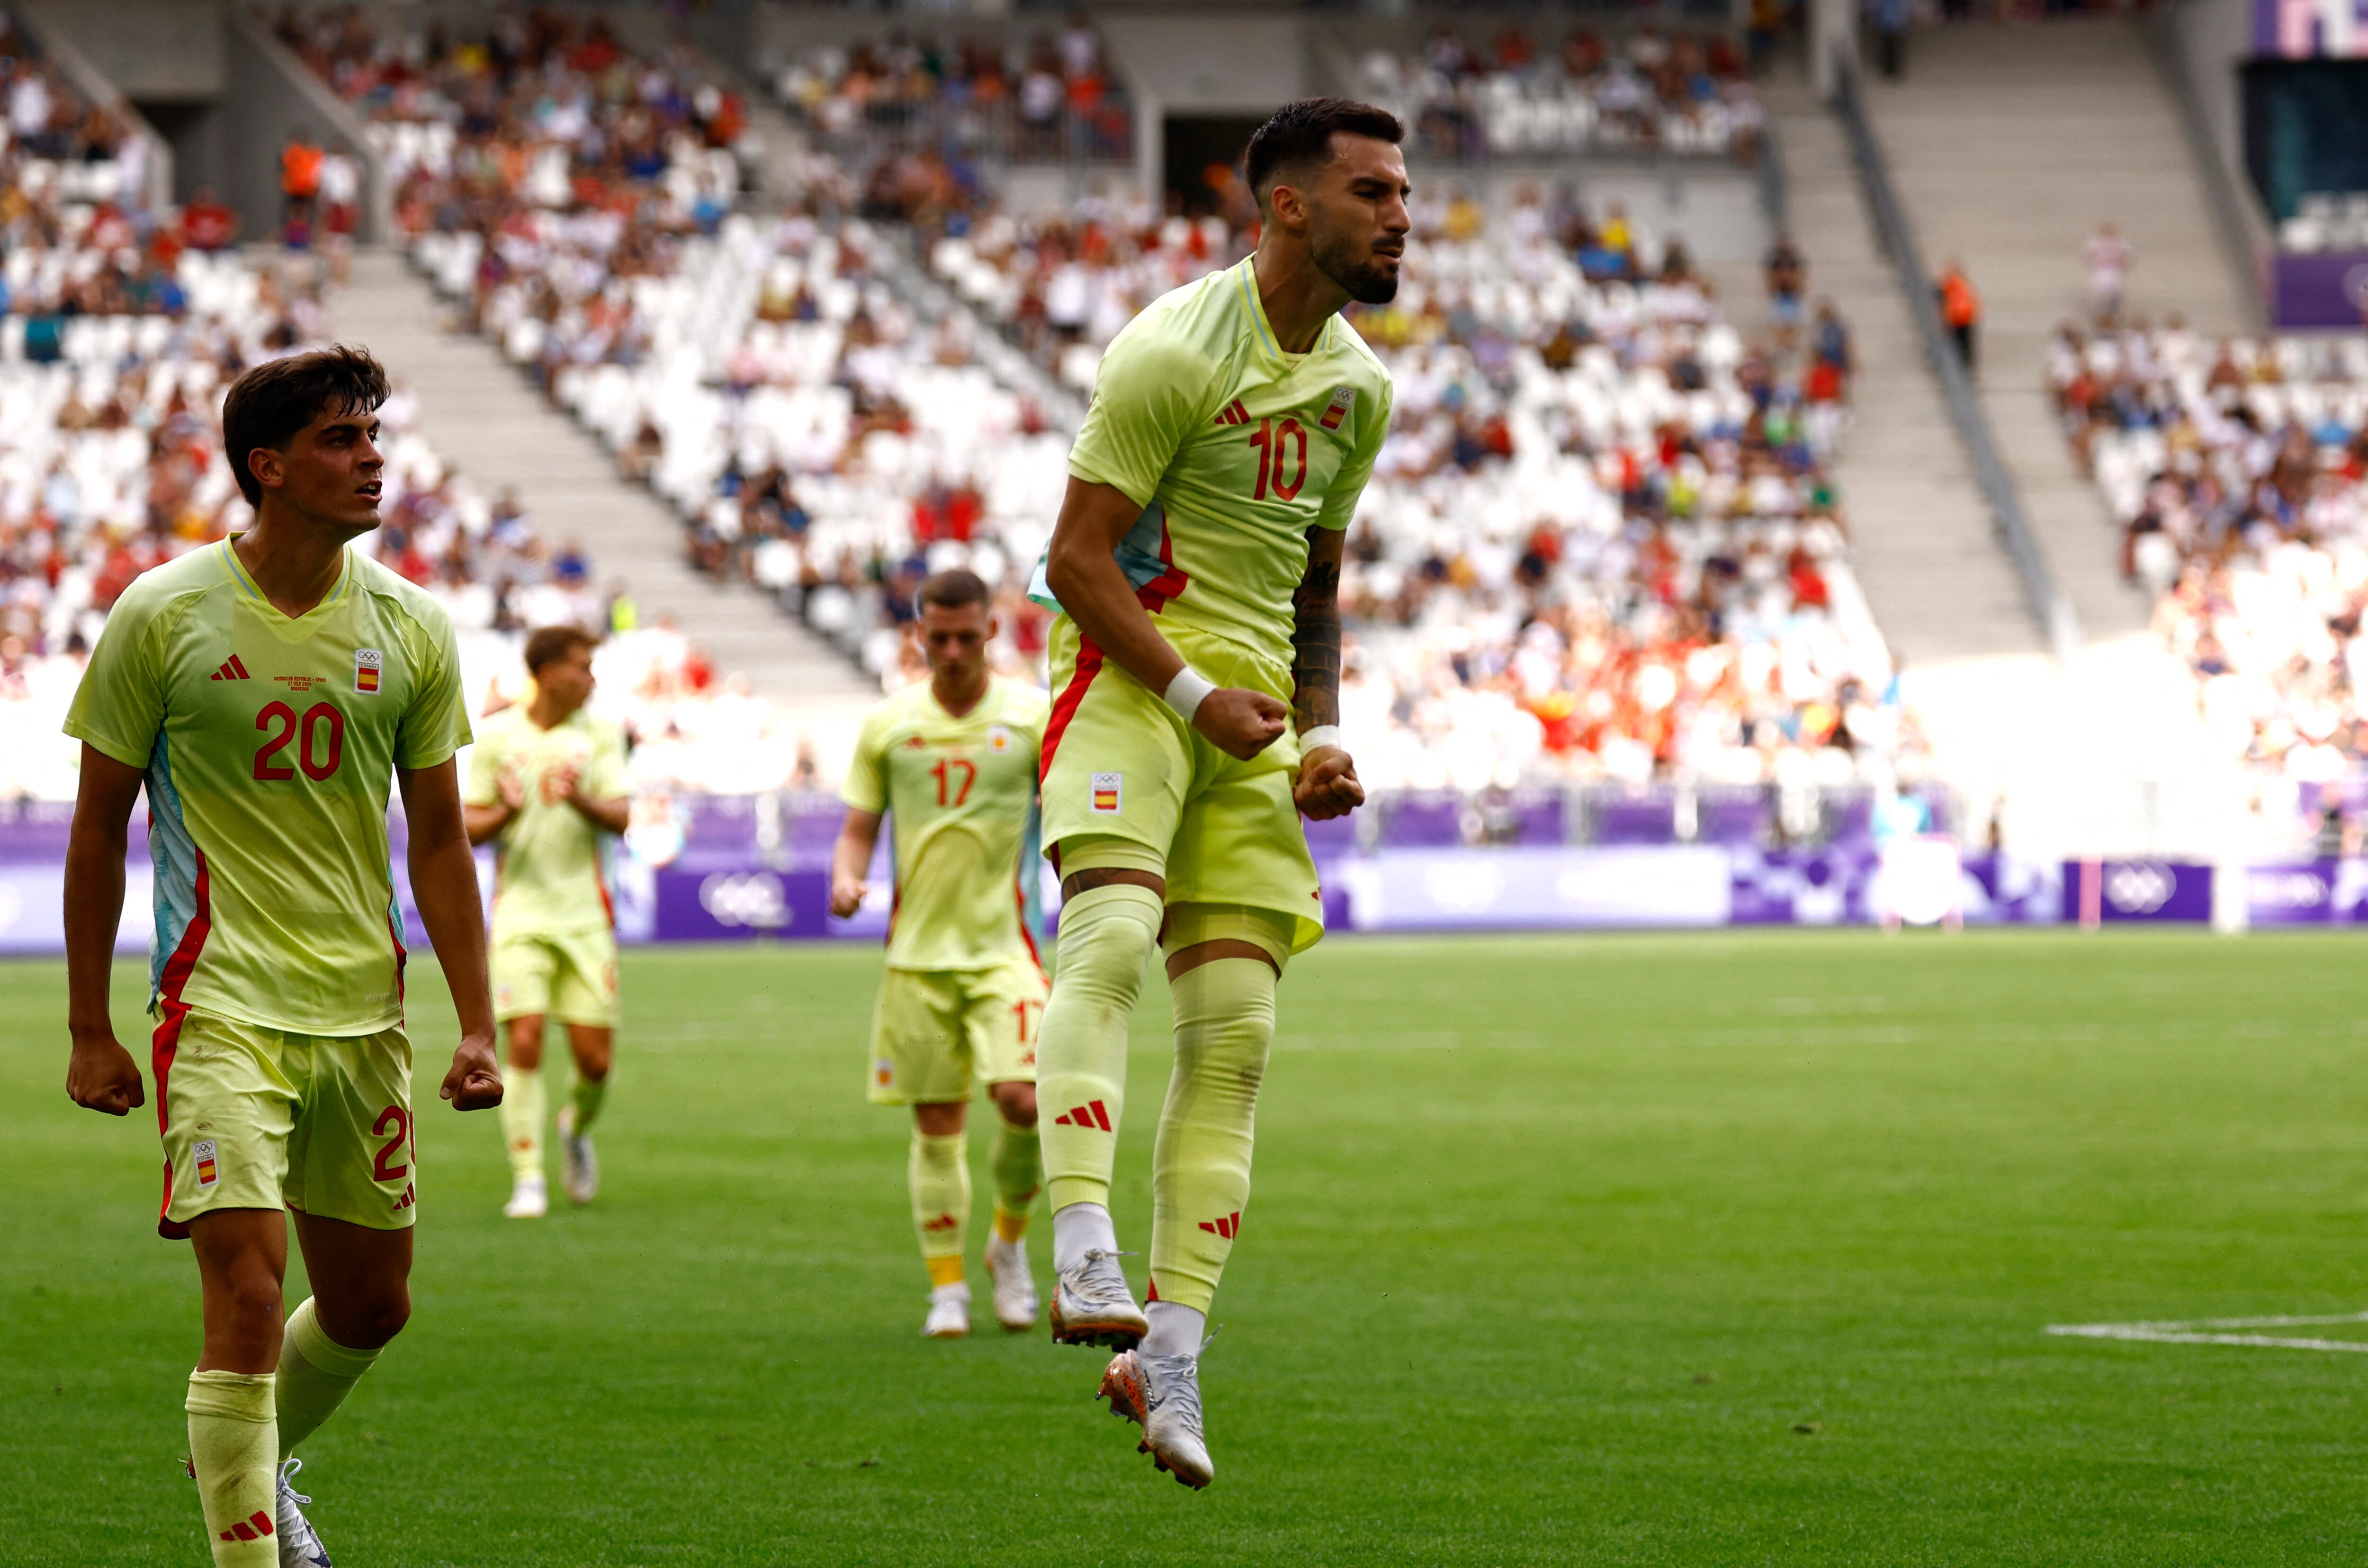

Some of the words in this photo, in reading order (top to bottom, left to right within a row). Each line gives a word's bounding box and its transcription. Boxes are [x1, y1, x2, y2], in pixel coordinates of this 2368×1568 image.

[1250, 418, 1307, 502] 10
[254, 700, 344, 781] 20
[928, 758, 978, 808] 17
[373, 1105, 415, 1181] 2
